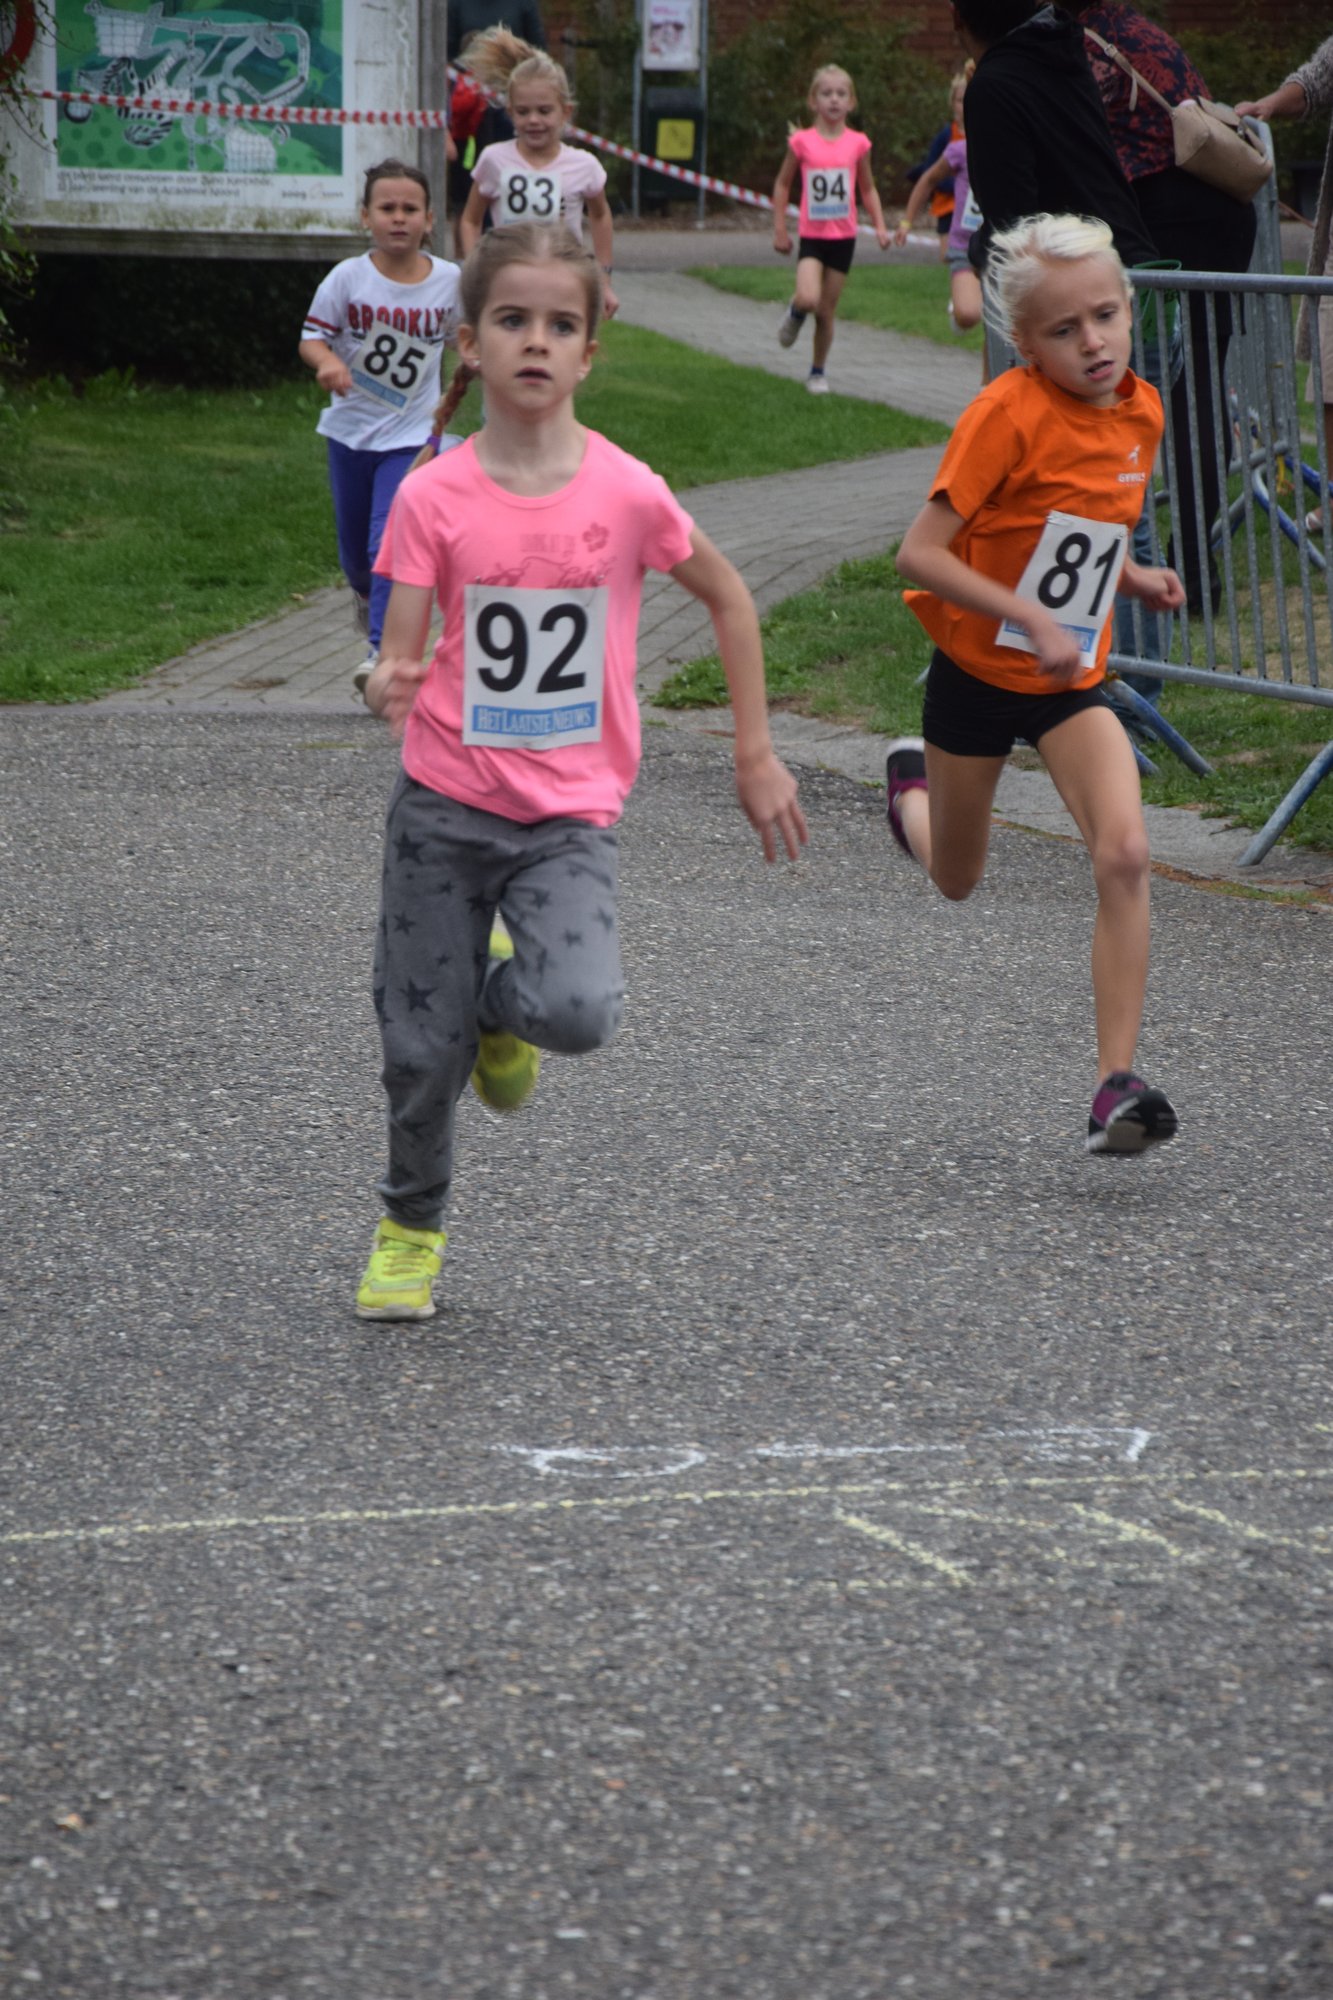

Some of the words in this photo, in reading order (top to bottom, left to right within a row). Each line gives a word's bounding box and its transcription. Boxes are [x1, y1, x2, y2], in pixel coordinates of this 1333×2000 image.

[507, 174, 554, 216] 83
[812, 173, 847, 202] 94
[348, 303, 453, 338] BROOKLY
[364, 333, 426, 389] 85
[1037, 531, 1121, 617] 81
[476, 601, 589, 693] 92
